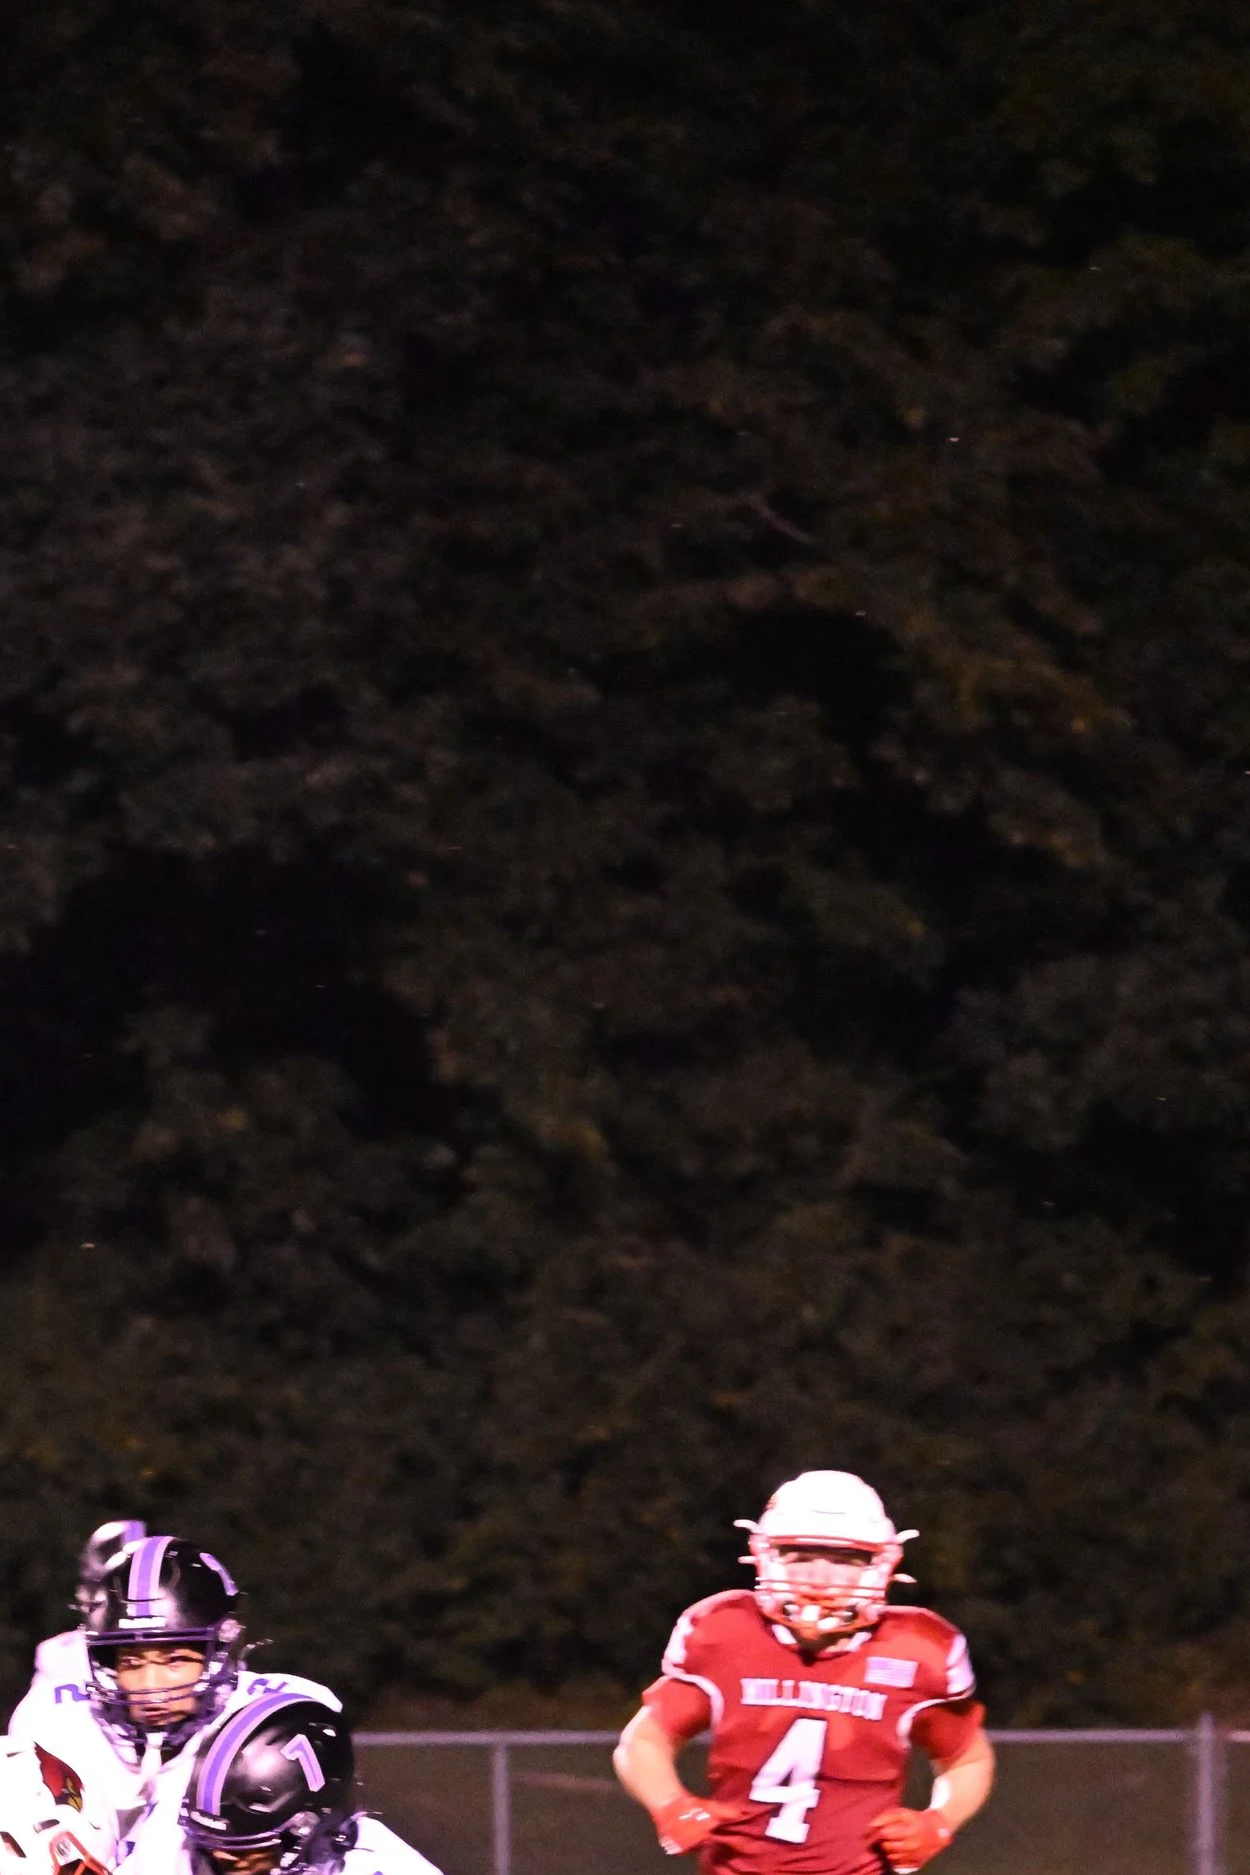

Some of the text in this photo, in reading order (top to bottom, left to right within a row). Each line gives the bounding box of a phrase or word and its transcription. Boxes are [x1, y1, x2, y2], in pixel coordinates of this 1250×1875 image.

[739, 1677, 889, 1721] MILLINGTON
[279, 1733, 326, 1792] 7
[748, 1717, 829, 1844] 4
